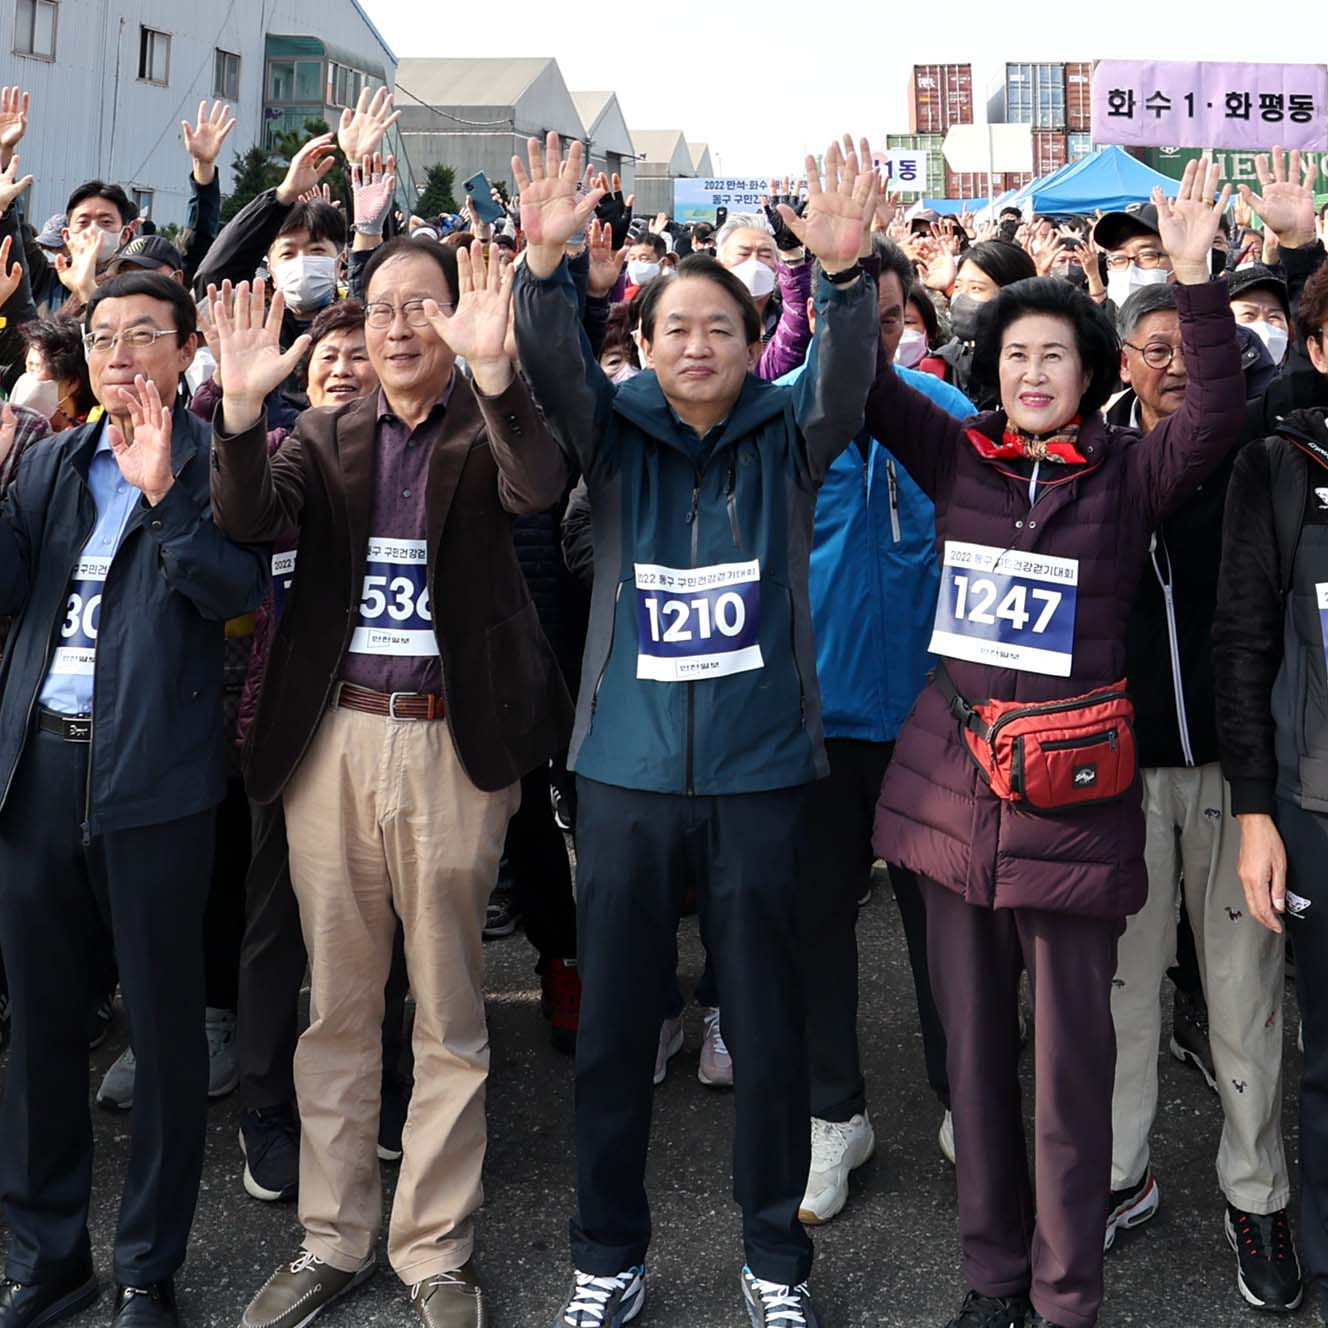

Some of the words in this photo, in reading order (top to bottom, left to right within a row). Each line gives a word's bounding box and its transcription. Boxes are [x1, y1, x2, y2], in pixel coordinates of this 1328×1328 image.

[704, 180, 725, 190] 2022
[712, 194, 731, 205] 동구
[274, 558, 292, 570] 2022
[951, 550, 972, 563] 2022
[974, 553, 993, 566] 동구
[997, 557, 1074, 579] 구민건강걷기대회
[659, 574, 675, 586] 동구
[677, 567, 756, 588] 구민건강걷기대회
[954, 575, 1063, 634] 1247
[644, 591, 746, 643] 1210
